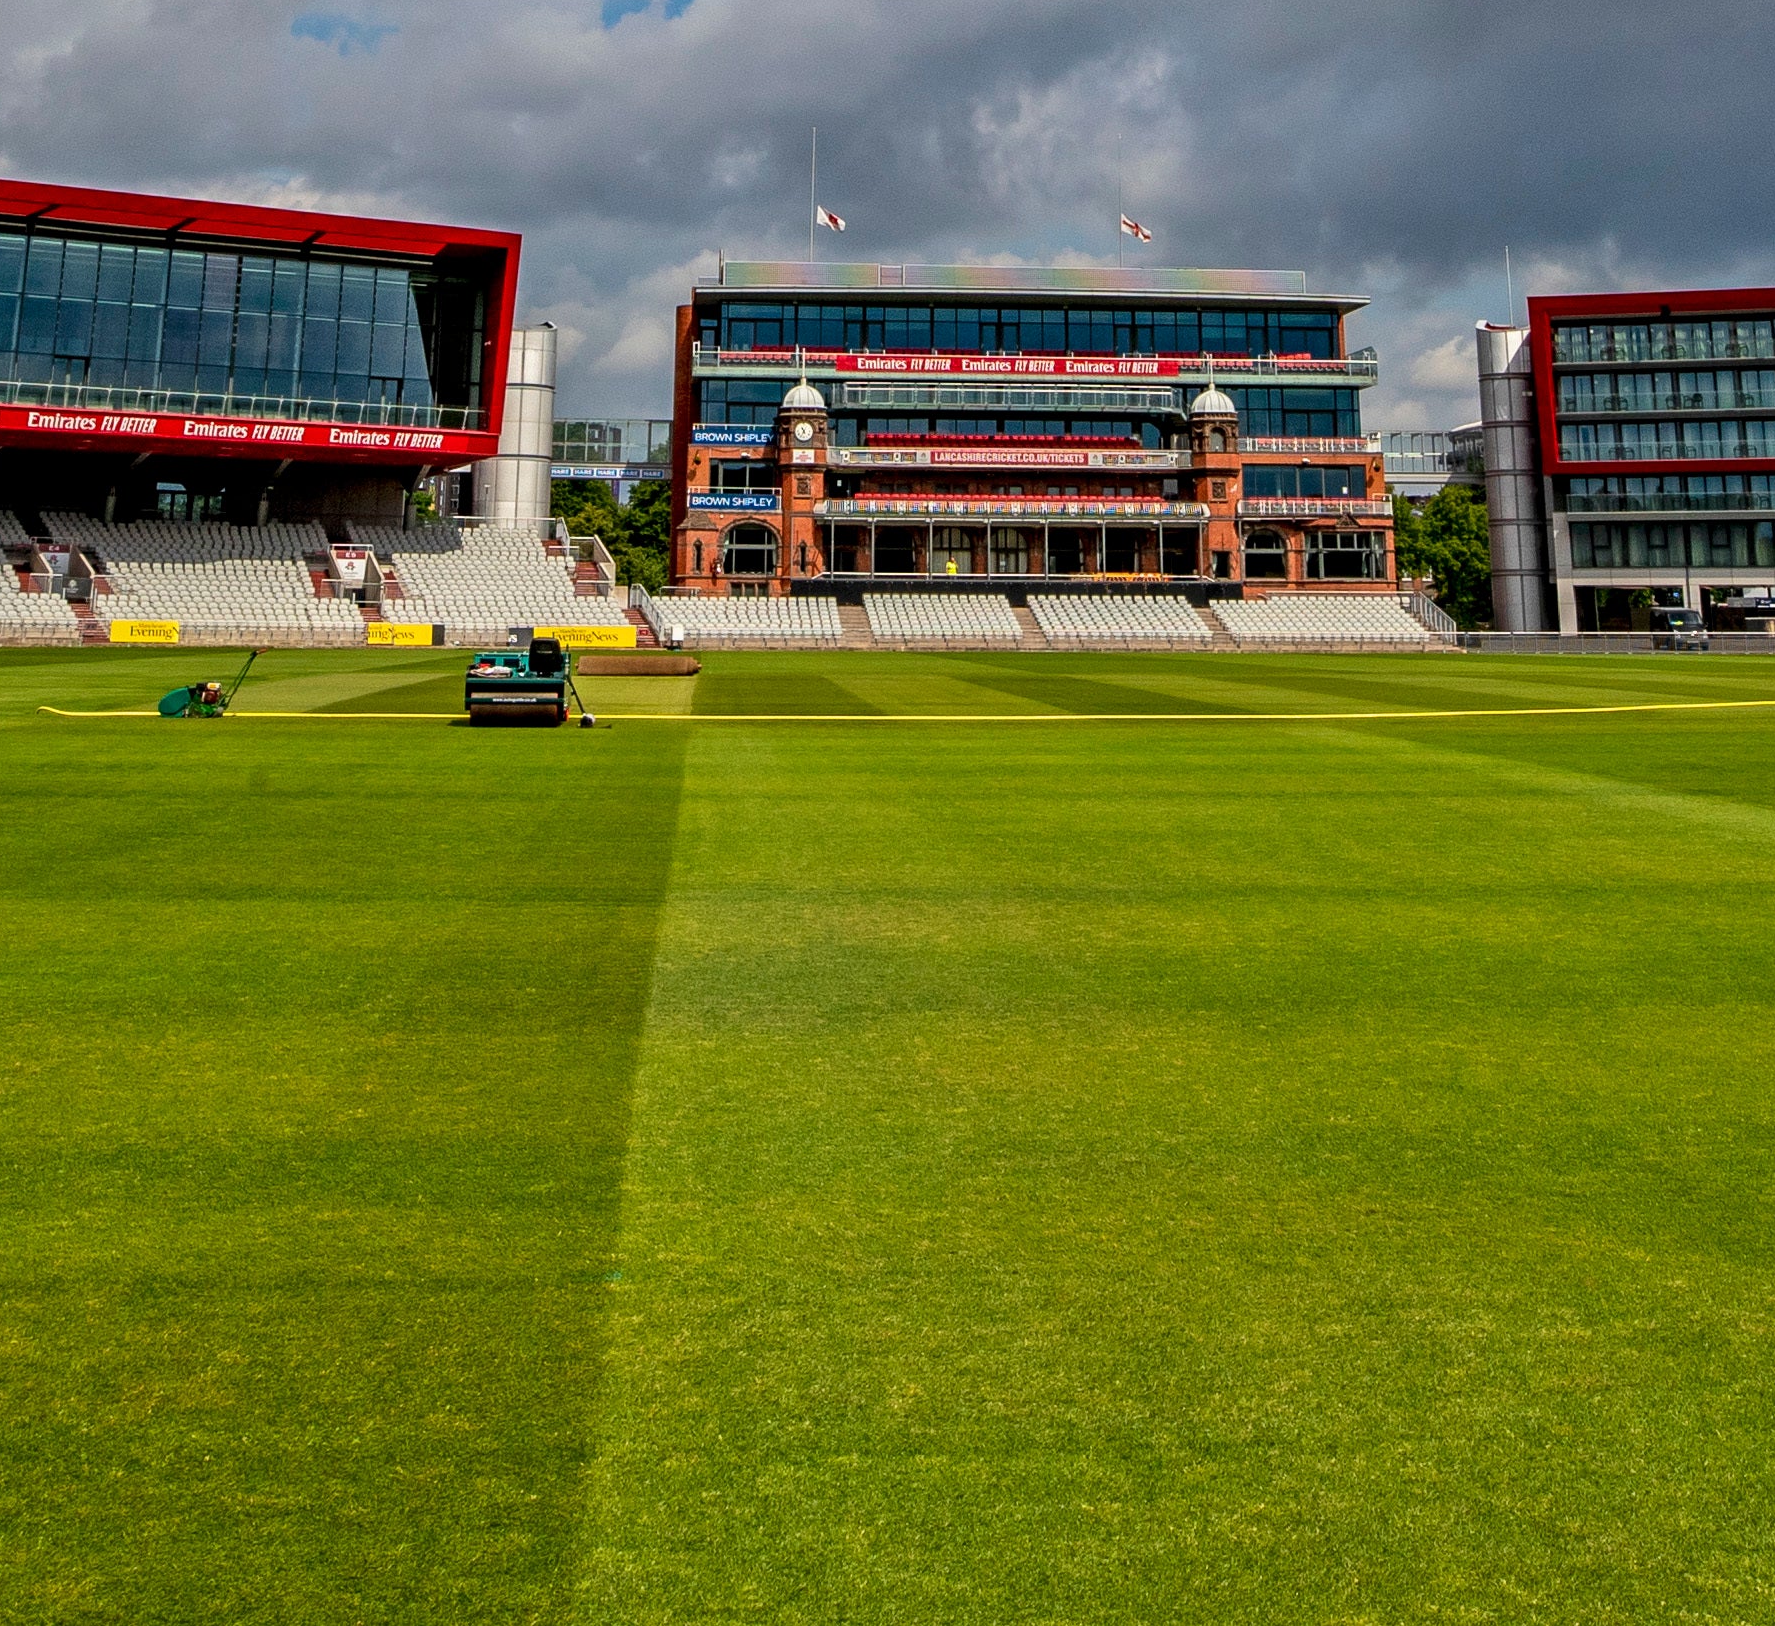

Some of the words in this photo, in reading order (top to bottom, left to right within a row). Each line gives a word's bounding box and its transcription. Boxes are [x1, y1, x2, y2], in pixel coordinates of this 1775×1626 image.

[857, 358, 907, 371] Emirates
[911, 359, 925, 370] FLY
[925, 359, 951, 371] BETTER
[962, 359, 1011, 372] Emirates
[1015, 360, 1029, 371] FLY
[1029, 360, 1055, 372] BETTER
[1065, 360, 1115, 373] Emirates
[1118, 361, 1132, 373] FLY
[1132, 362, 1158, 374] BETTER
[28, 412, 96, 431] Emirates
[100, 416, 119, 432] FLY
[119, 418, 156, 434] BETTER
[183, 421, 248, 439] Emirates
[252, 424, 270, 440] FLY
[270, 426, 305, 442] BETTER
[694, 432, 732, 442] BROWN
[734, 433, 775, 443] SHIPLEY
[329, 428, 390, 446] Emirates
[393, 432, 411, 447] FLY
[411, 433, 444, 449] BETTER
[934, 452, 1085, 464] LANCASHIRECRICKET.CO.UK/TICKETS
[692, 496, 730, 505] BROWN
[732, 497, 773, 506] SHIPLEY
